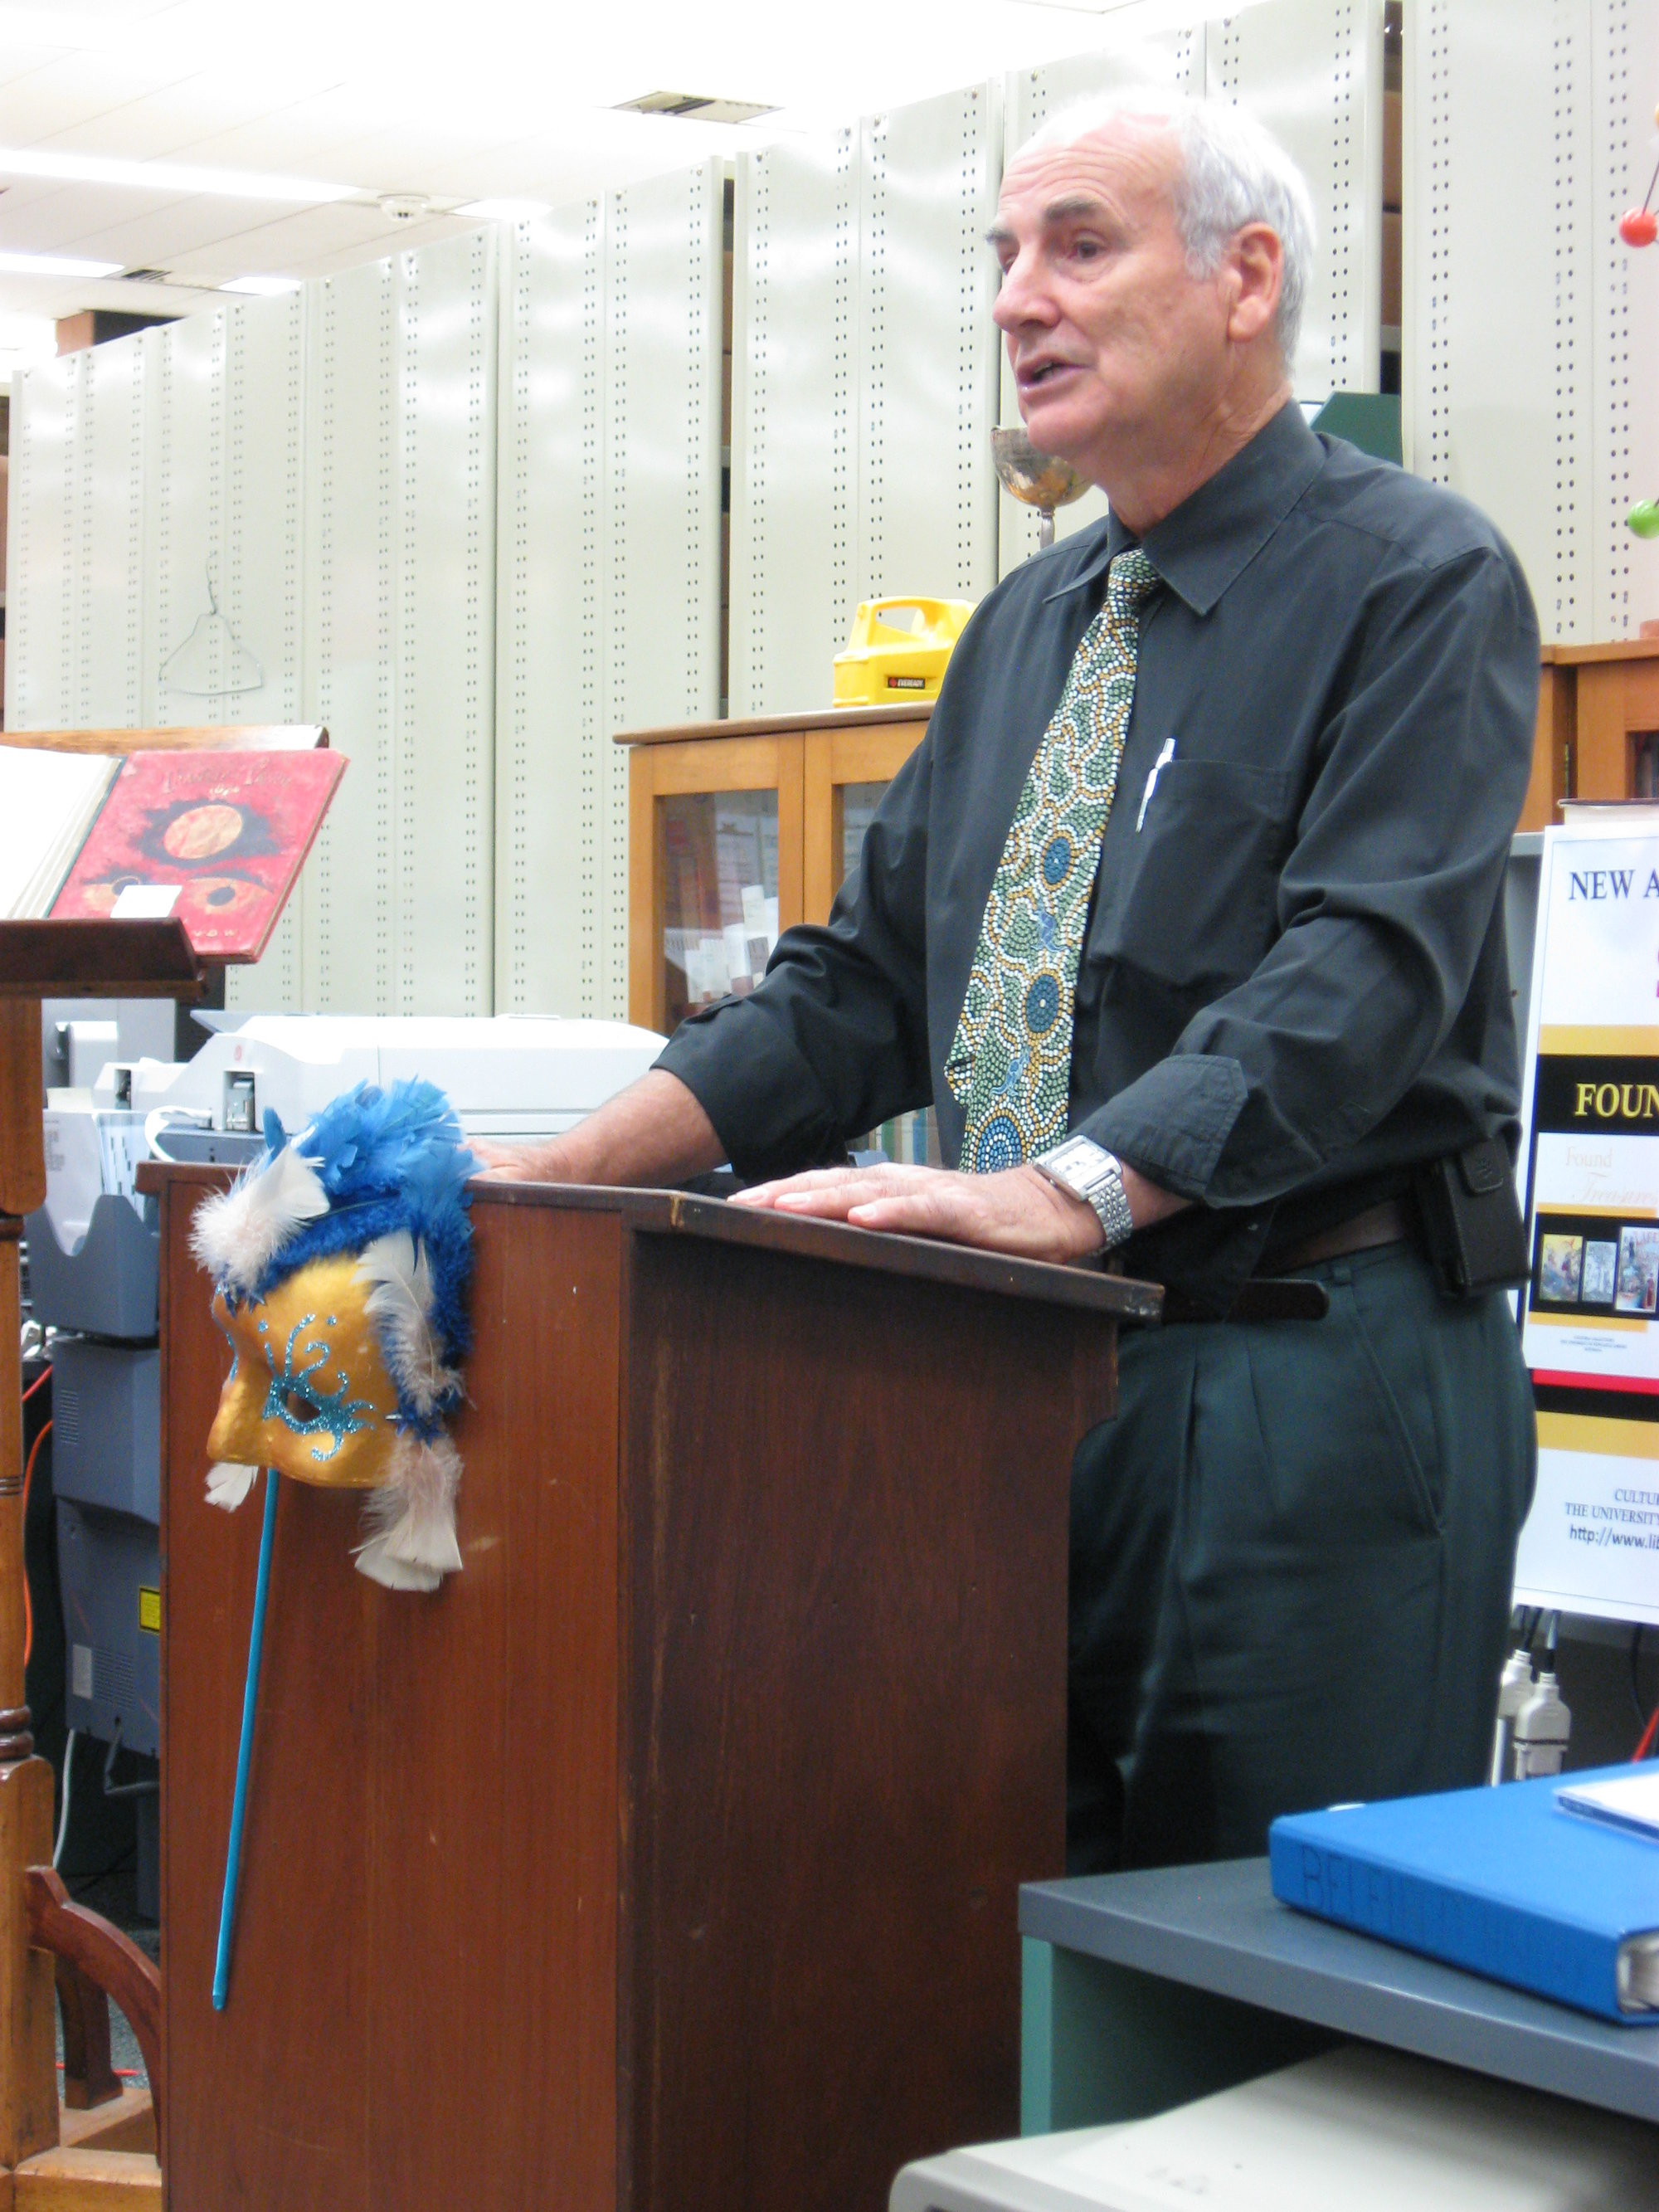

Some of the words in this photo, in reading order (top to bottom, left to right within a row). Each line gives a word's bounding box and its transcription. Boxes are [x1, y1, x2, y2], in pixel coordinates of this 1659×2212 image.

[1568, 869, 1636, 901] NEW
[1574, 1083, 1659, 1118] FOUN
[1566, 1146, 1613, 1167] Found
[1564, 1502, 1588, 1518] THE
